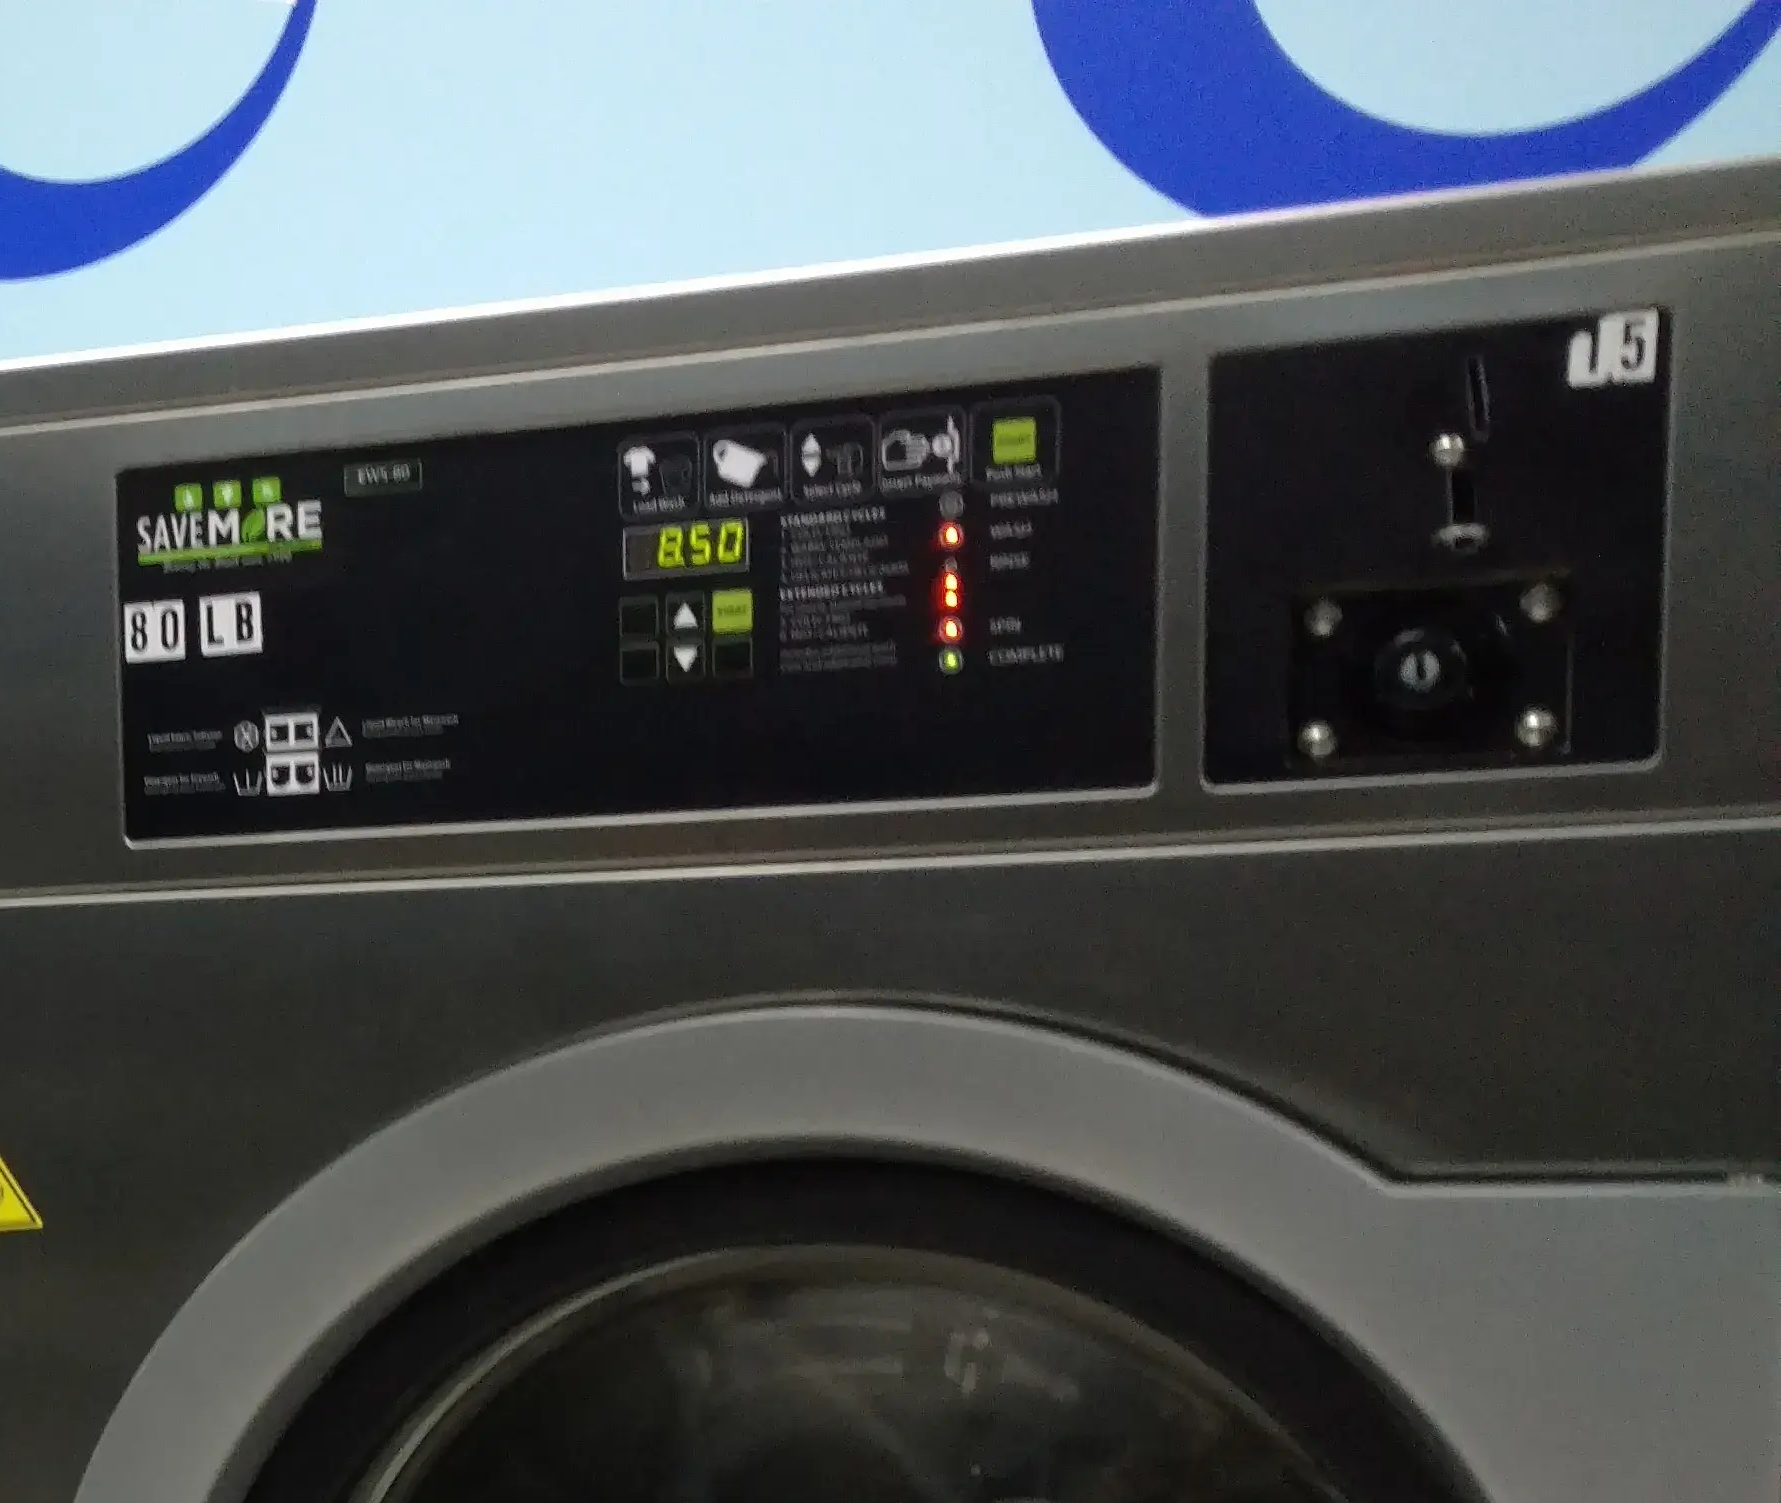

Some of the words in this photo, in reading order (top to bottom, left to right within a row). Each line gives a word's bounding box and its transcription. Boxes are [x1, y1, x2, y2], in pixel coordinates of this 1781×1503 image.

[1587, 319, 1646, 373] 15
[130, 608, 179, 651] 80
[206, 601, 254, 647] LB
